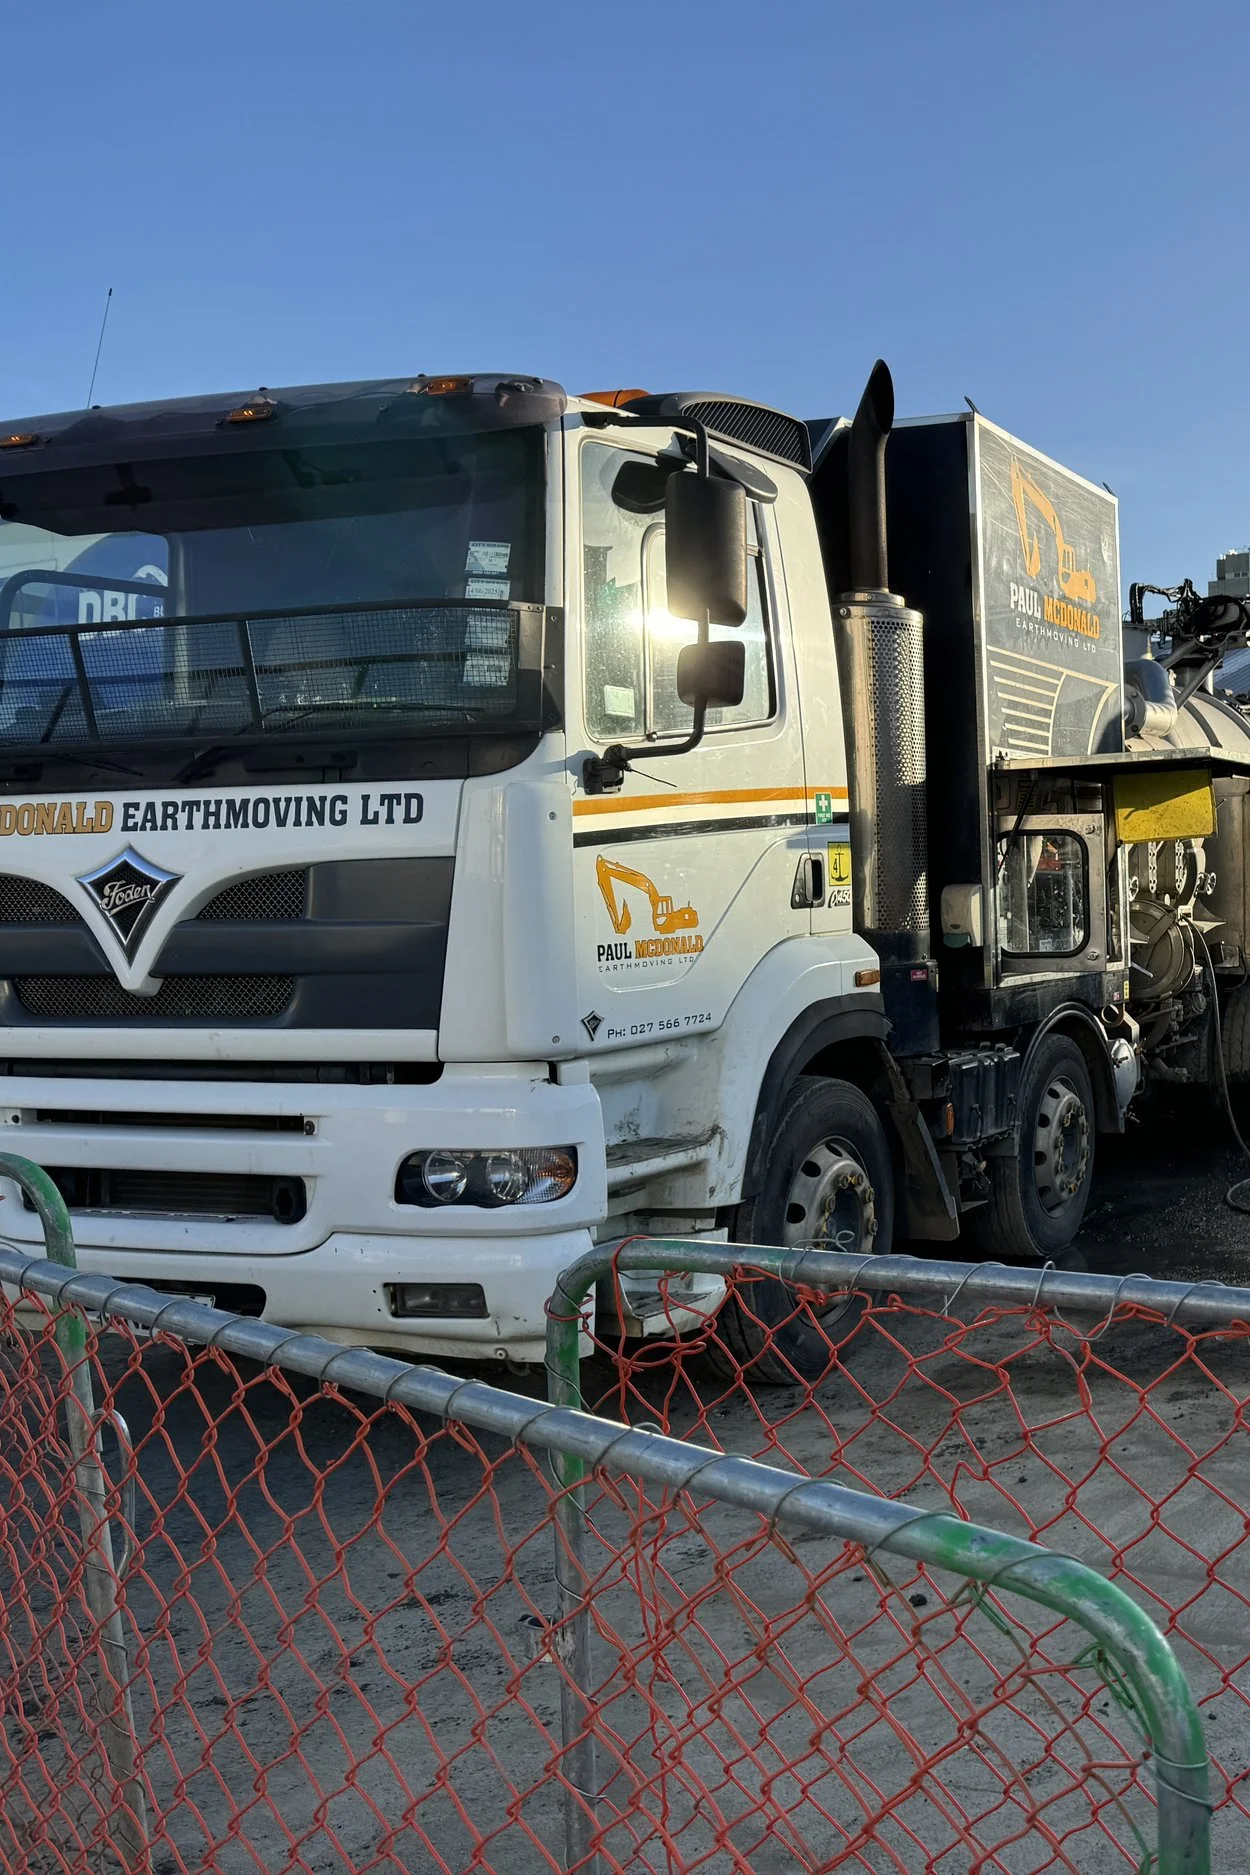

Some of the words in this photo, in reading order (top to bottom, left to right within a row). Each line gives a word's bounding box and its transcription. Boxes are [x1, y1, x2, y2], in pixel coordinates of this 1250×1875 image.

[1009, 582, 1041, 620] PAUL
[1043, 594, 1101, 640] MCDONALD
[1016, 617, 1079, 648] EARTHMOVING
[1083, 641, 1096, 653] LTD
[121, 794, 348, 832] EARTHMOVING
[360, 793, 424, 825] LTD
[101, 880, 155, 916] Foden
[597, 942, 632, 962] PAUL
[634, 935, 704, 959] MCDONALD
[599, 958, 673, 973] EARTHMOVING
[678, 956, 694, 964] LTD
[630, 1022, 653, 1035] 027
[658, 1018, 680, 1030] 566
[684, 1012, 711, 1026] 7724
